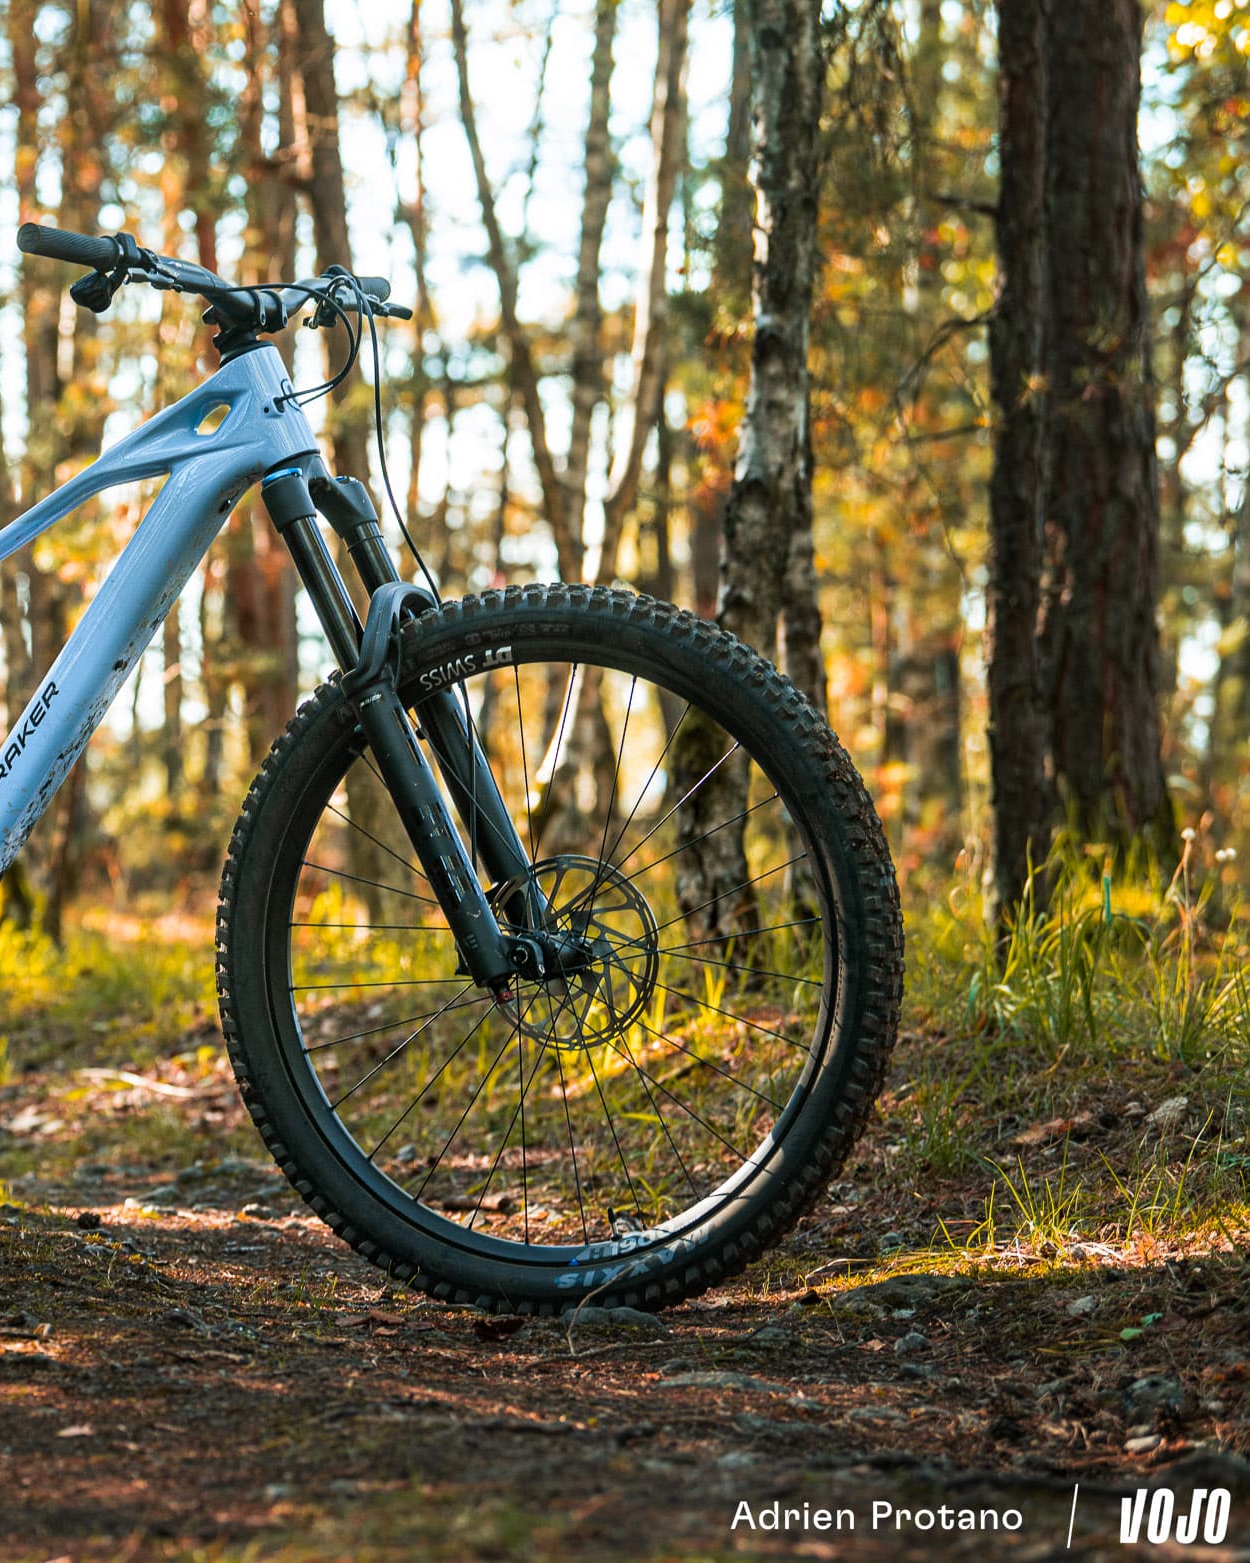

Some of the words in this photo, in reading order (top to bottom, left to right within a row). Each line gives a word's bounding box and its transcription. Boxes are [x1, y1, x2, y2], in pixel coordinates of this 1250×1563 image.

[419, 654, 476, 691] SWISS
[483, 645, 513, 668] DT
[553, 1224, 710, 1288] MAXXIS
